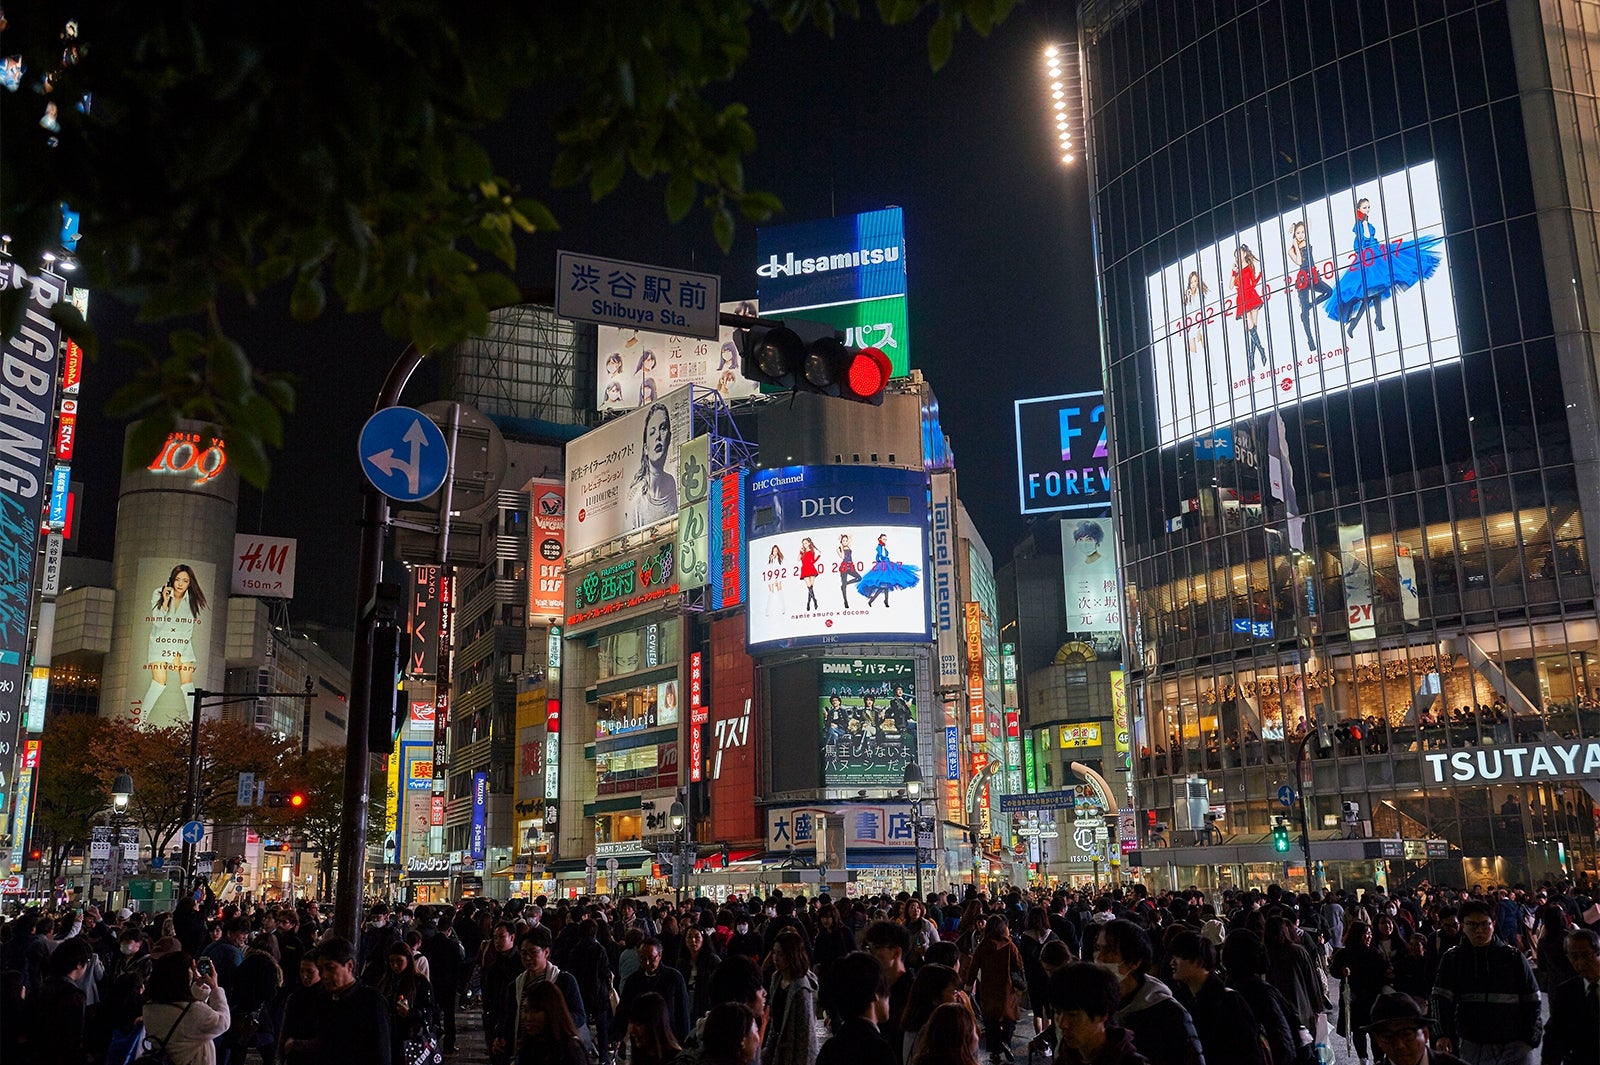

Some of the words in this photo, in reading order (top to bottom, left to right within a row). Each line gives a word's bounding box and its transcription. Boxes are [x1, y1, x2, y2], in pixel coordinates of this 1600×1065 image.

[756, 247, 899, 278] Hisamitsu
[571, 263, 706, 310] 渋谷駅前
[1175, 307, 1214, 337] 1992
[1224, 283, 1271, 317] 20
[1284, 261, 1335, 294] 2010
[1348, 238, 1404, 272] 2017
[592, 300, 654, 323] Shibuya
[660, 310, 691, 327] Sta.
[694, 345, 708, 356] 46
[1306, 345, 1350, 366] docomo
[61, 425, 73, 454] ガスト
[168, 432, 226, 448] SHIBYA
[146, 439, 227, 484] 109
[752, 480, 769, 491] DHC
[770, 474, 804, 487] Channel
[801, 495, 854, 518] DHC
[681, 455, 708, 582] もんじゃ
[934, 496, 951, 567] Taisei
[46, 539, 59, 591] 渋谷駅前ビル
[239, 543, 289, 575] H&M
[762, 569, 787, 582] 1992
[793, 563, 824, 577] 20
[832, 561, 864, 573] 2010
[871, 561, 903, 573] 2017
[242, 580, 271, 590] 150m
[428, 567, 436, 600] TOKYO
[541, 579, 562, 592] B2F
[601, 570, 634, 601] 西村
[939, 572, 951, 631] neon
[1078, 580, 1093, 625] 三次元
[1103, 580, 1119, 625] 欅坂46
[175, 617, 202, 625] amuro
[414, 567, 428, 673] KATE
[791, 612, 810, 620] namie
[155, 636, 189, 645] docomo
[822, 635, 839, 643] DHC
[162, 650, 182, 658] 25th
[142, 664, 197, 673] anniversary
[823, 663, 851, 673] DMM
[130, 700, 142, 725] 199
[970, 687, 985, 735] 三千里
[600, 712, 655, 735] Euphoria
[660, 747, 677, 769] JTB
[824, 744, 915, 759] 馬主じゃないよ、
[414, 762, 432, 778] 薬
[1425, 743, 1600, 784] TSUTAYA
[774, 812, 912, 842] 大盛書店
[407, 855, 449, 872] グルメタウン
[1070, 855, 1105, 863] ITS'DEO
